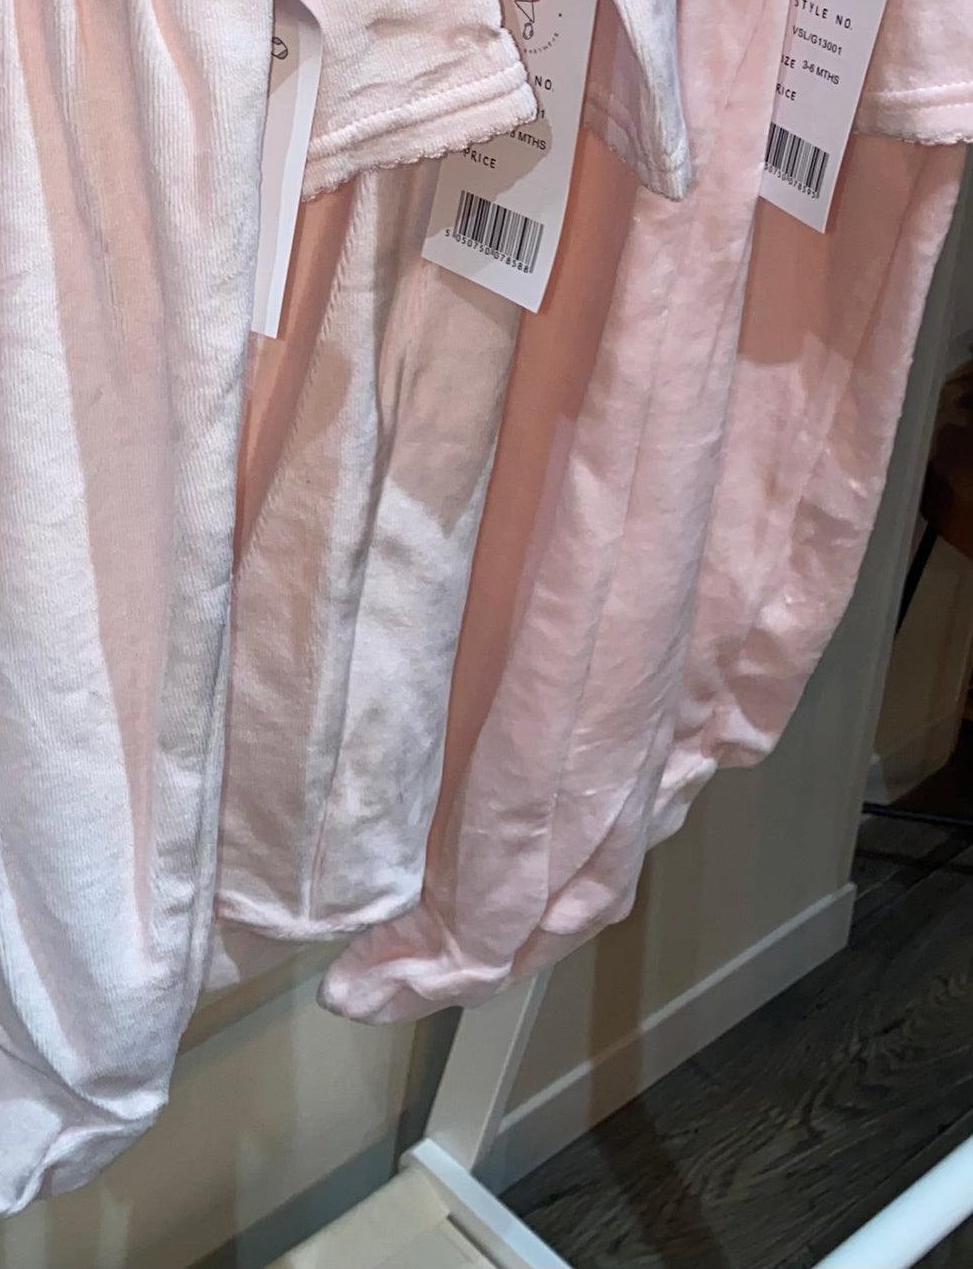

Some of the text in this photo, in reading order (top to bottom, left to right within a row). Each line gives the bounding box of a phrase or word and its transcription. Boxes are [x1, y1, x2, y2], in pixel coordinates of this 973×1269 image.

[792, 25, 842, 55] VSL/G13001
[781, 55, 840, 85] IZE 3-6 MTHS
[776, 83, 797, 101] RICE
[517, 131, 547, 151] MTHS
[463, 147, 497, 169] PRICE
